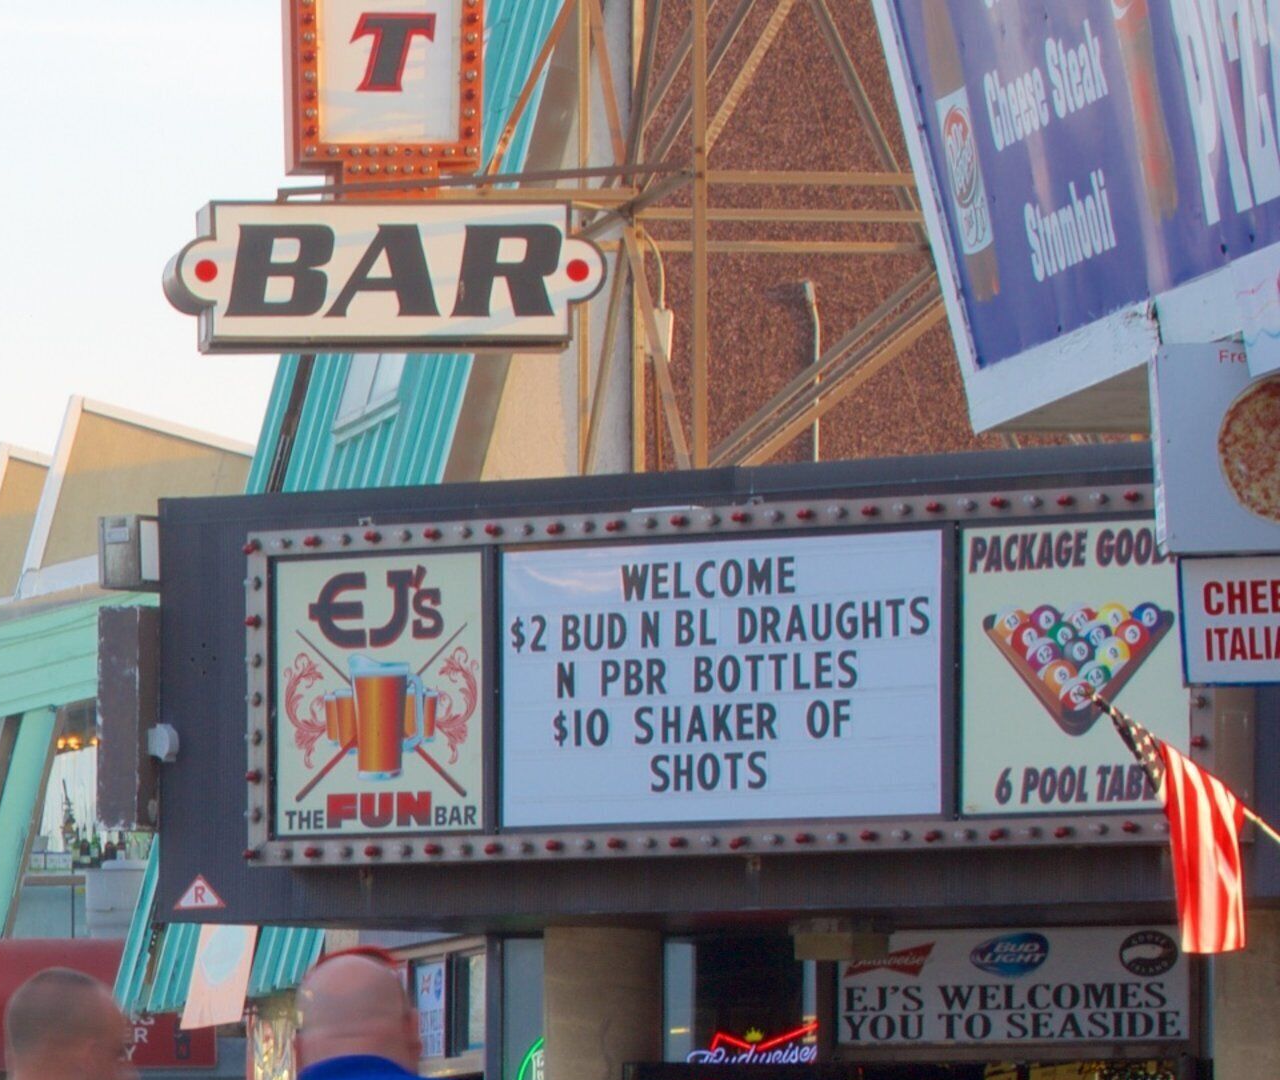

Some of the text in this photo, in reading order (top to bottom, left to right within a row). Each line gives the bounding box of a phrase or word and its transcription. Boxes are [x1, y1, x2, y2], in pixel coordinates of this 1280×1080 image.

[349, 12, 437, 92] T
[983, 18, 1109, 152] Cheese Steak
[1023, 168, 1117, 283] Stromboli
[223, 223, 555, 317] BAR
[1219, 349, 1247, 364] Fre
[968, 527, 1178, 574] PACKAGE GOO
[621, 556, 796, 601] WELCOME
[1202, 579, 1280, 617] CHEE
[510, 596, 930, 653] $2 BUD N BL DRAUGHTS
[556, 650, 858, 698] N PBR BOTTLES
[553, 699, 852, 747] $10 SHAKER OF
[650, 750, 768, 792] SHOTS
[995, 762, 1157, 804] 6 POOL TABL
[285, 791, 477, 830] THE FUN BAR
[194, 885, 205, 903] R
[978, 949, 1047, 963] LIGHT
[994, 941, 1041, 953] BUD
[844, 982, 1168, 1013] EJ'S WELCOMES
[843, 1011, 1182, 1041] YOU TO SEASIDE
